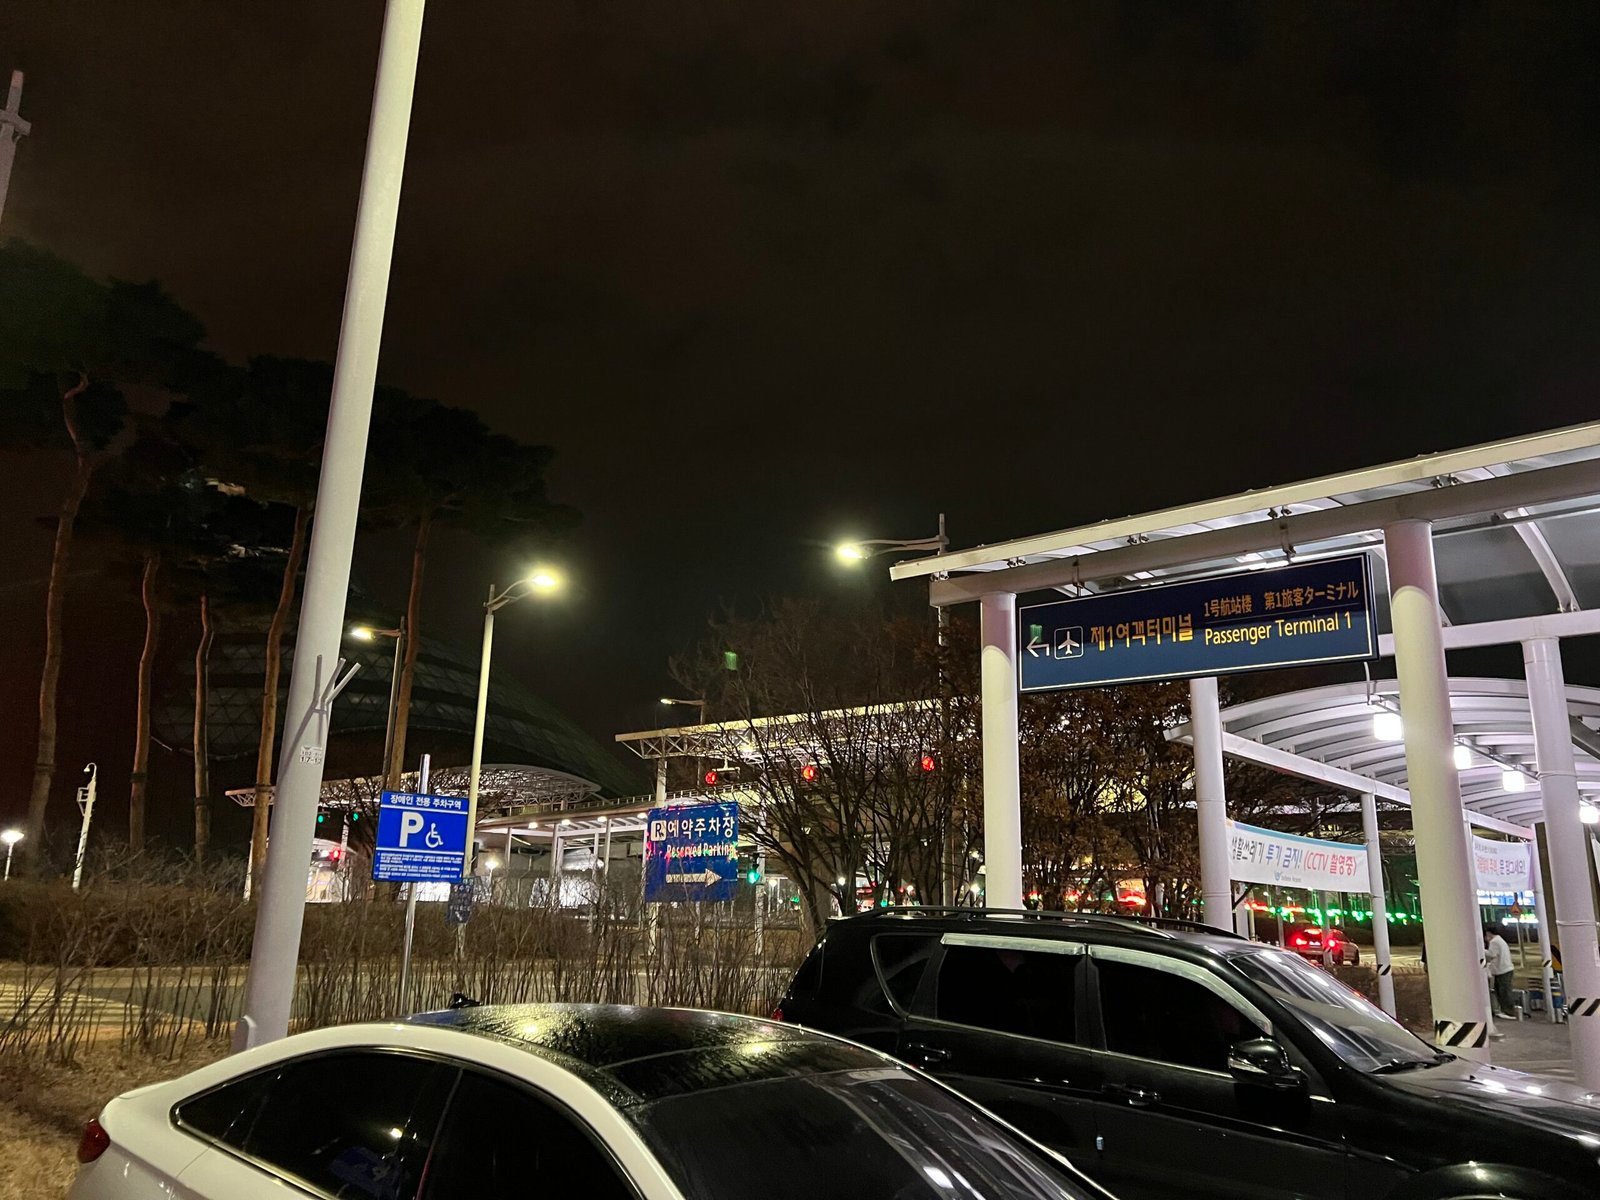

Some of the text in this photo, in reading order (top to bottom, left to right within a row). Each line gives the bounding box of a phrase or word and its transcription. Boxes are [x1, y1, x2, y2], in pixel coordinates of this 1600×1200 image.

[1204, 581, 1359, 617] 1号航站楼 第1旅客ターミナル
[1090, 613, 1193, 651] 제1여객터미널
[1204, 611, 1352, 646] Passenger Terminal 1
[390, 794, 462, 810] 장애인 전용 주차구역
[399, 811, 424, 847] P
[668, 816, 735, 839] 예약주차장
[667, 841, 736, 859] Reserved Parking
[1265, 844, 1282, 866] 투기
[1282, 847, 1303, 869] 금지!
[1303, 850, 1329, 871] (CCTV
[1329, 854, 1357, 877] 촬영중)
